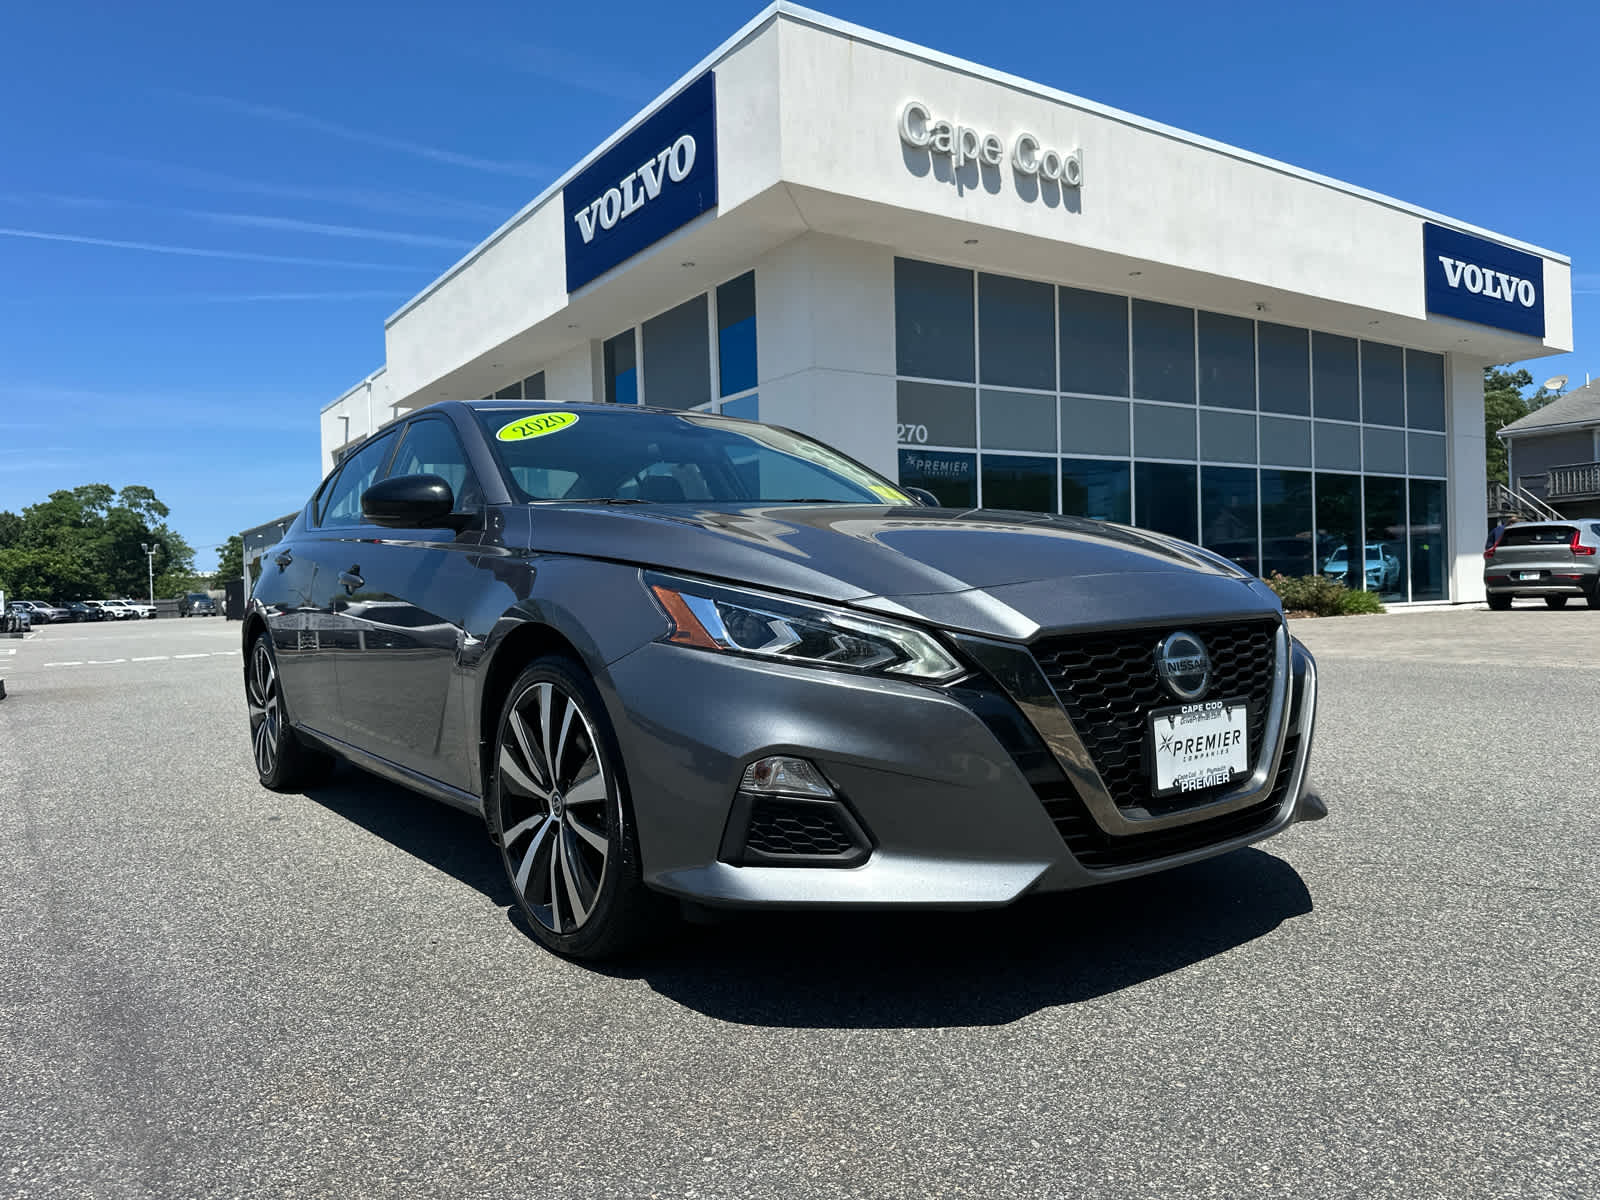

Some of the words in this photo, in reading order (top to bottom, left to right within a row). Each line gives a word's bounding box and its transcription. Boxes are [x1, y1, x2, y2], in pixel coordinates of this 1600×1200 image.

[899, 101, 1003, 167] Cape
[1012, 132, 1084, 188] Cod
[574, 134, 697, 244] VOLVO
[1438, 255, 1536, 308] VOLVO
[511, 414, 567, 437] 2020
[896, 423, 929, 443] 270
[915, 459, 969, 473] PREMIER
[1167, 659, 1208, 673] NISSA
[1181, 703, 1205, 714] CAPE
[1173, 729, 1241, 757] PREMIER
[1181, 772, 1230, 793] PREMIER
